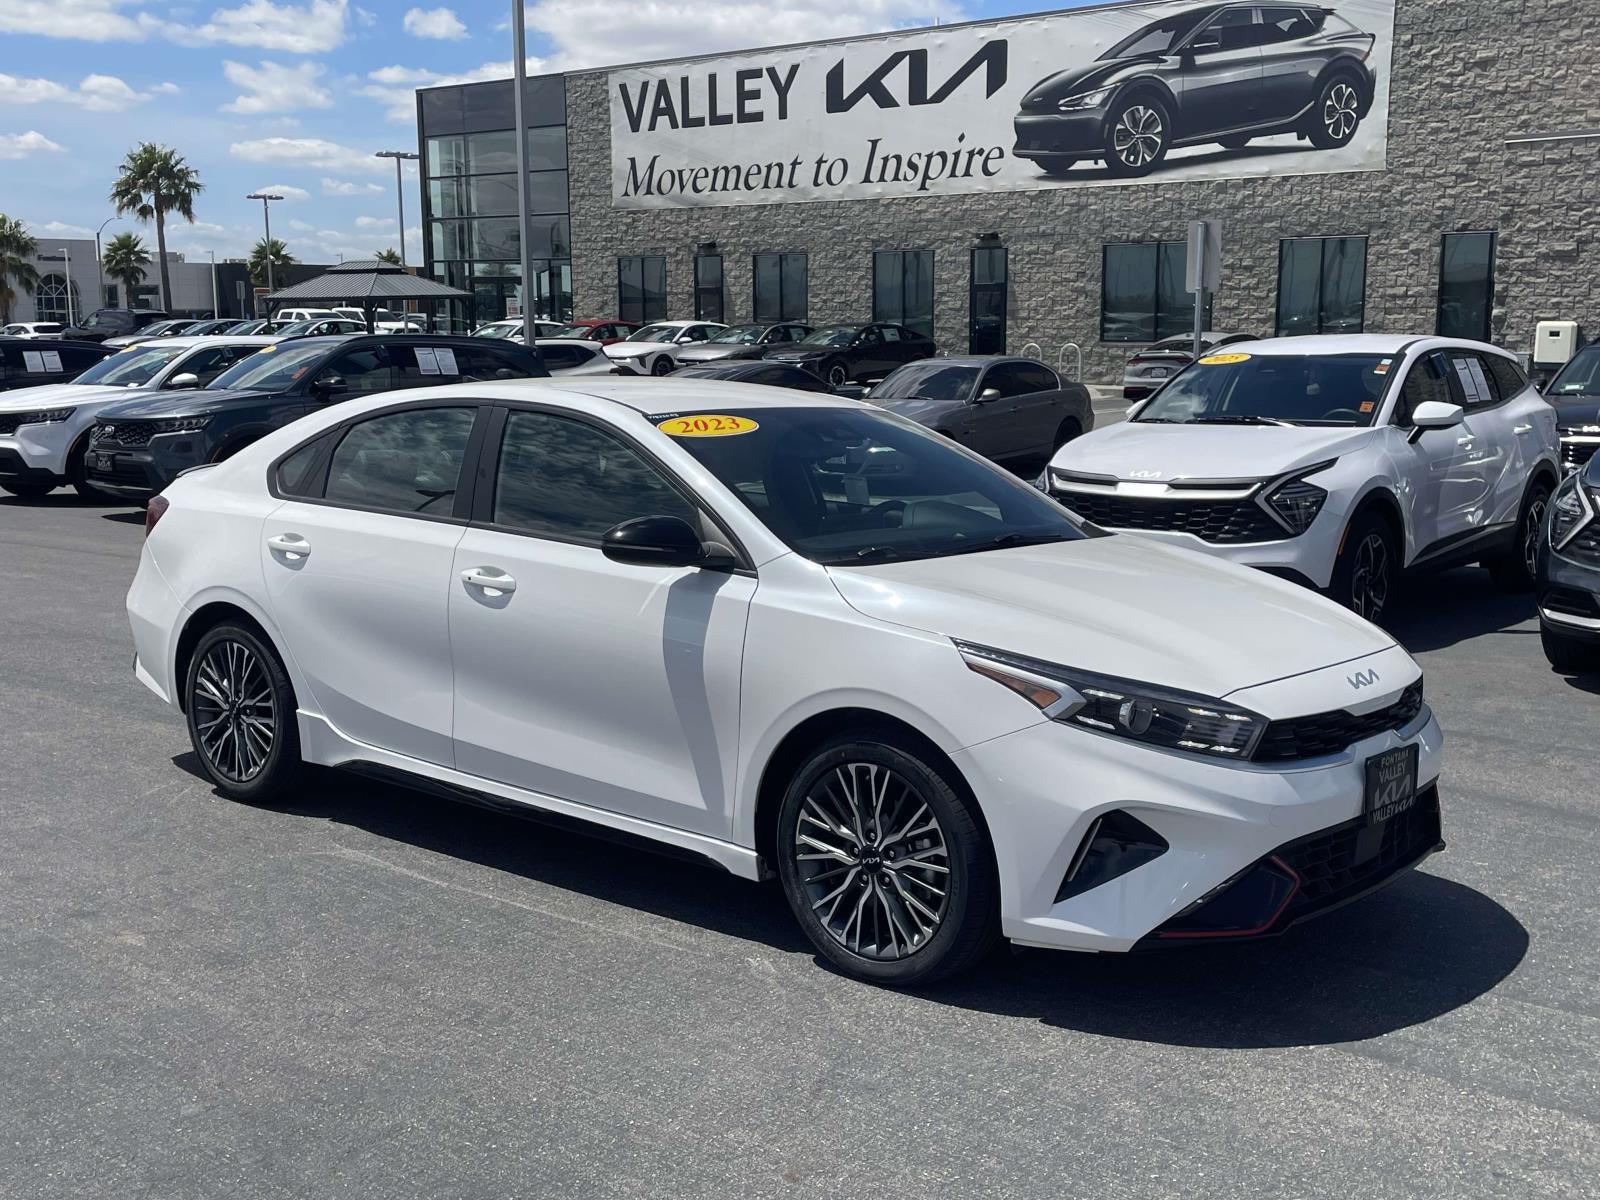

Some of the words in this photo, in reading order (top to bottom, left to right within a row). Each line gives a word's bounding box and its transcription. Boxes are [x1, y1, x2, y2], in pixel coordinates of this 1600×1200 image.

[619, 63, 800, 133] VALLEY
[825, 38, 1008, 114] KIA
[621, 154, 803, 198] Movement
[811, 152, 848, 188] to
[860, 132, 1005, 192] Inspire
[677, 417, 740, 433] 2023
[1129, 470, 1162, 478] KIA
[1347, 668, 1380, 690] KIA
[1379, 761, 1406, 784] VALLEY
[1374, 774, 1411, 809] KIA
[1372, 804, 1395, 824] VALLEY
